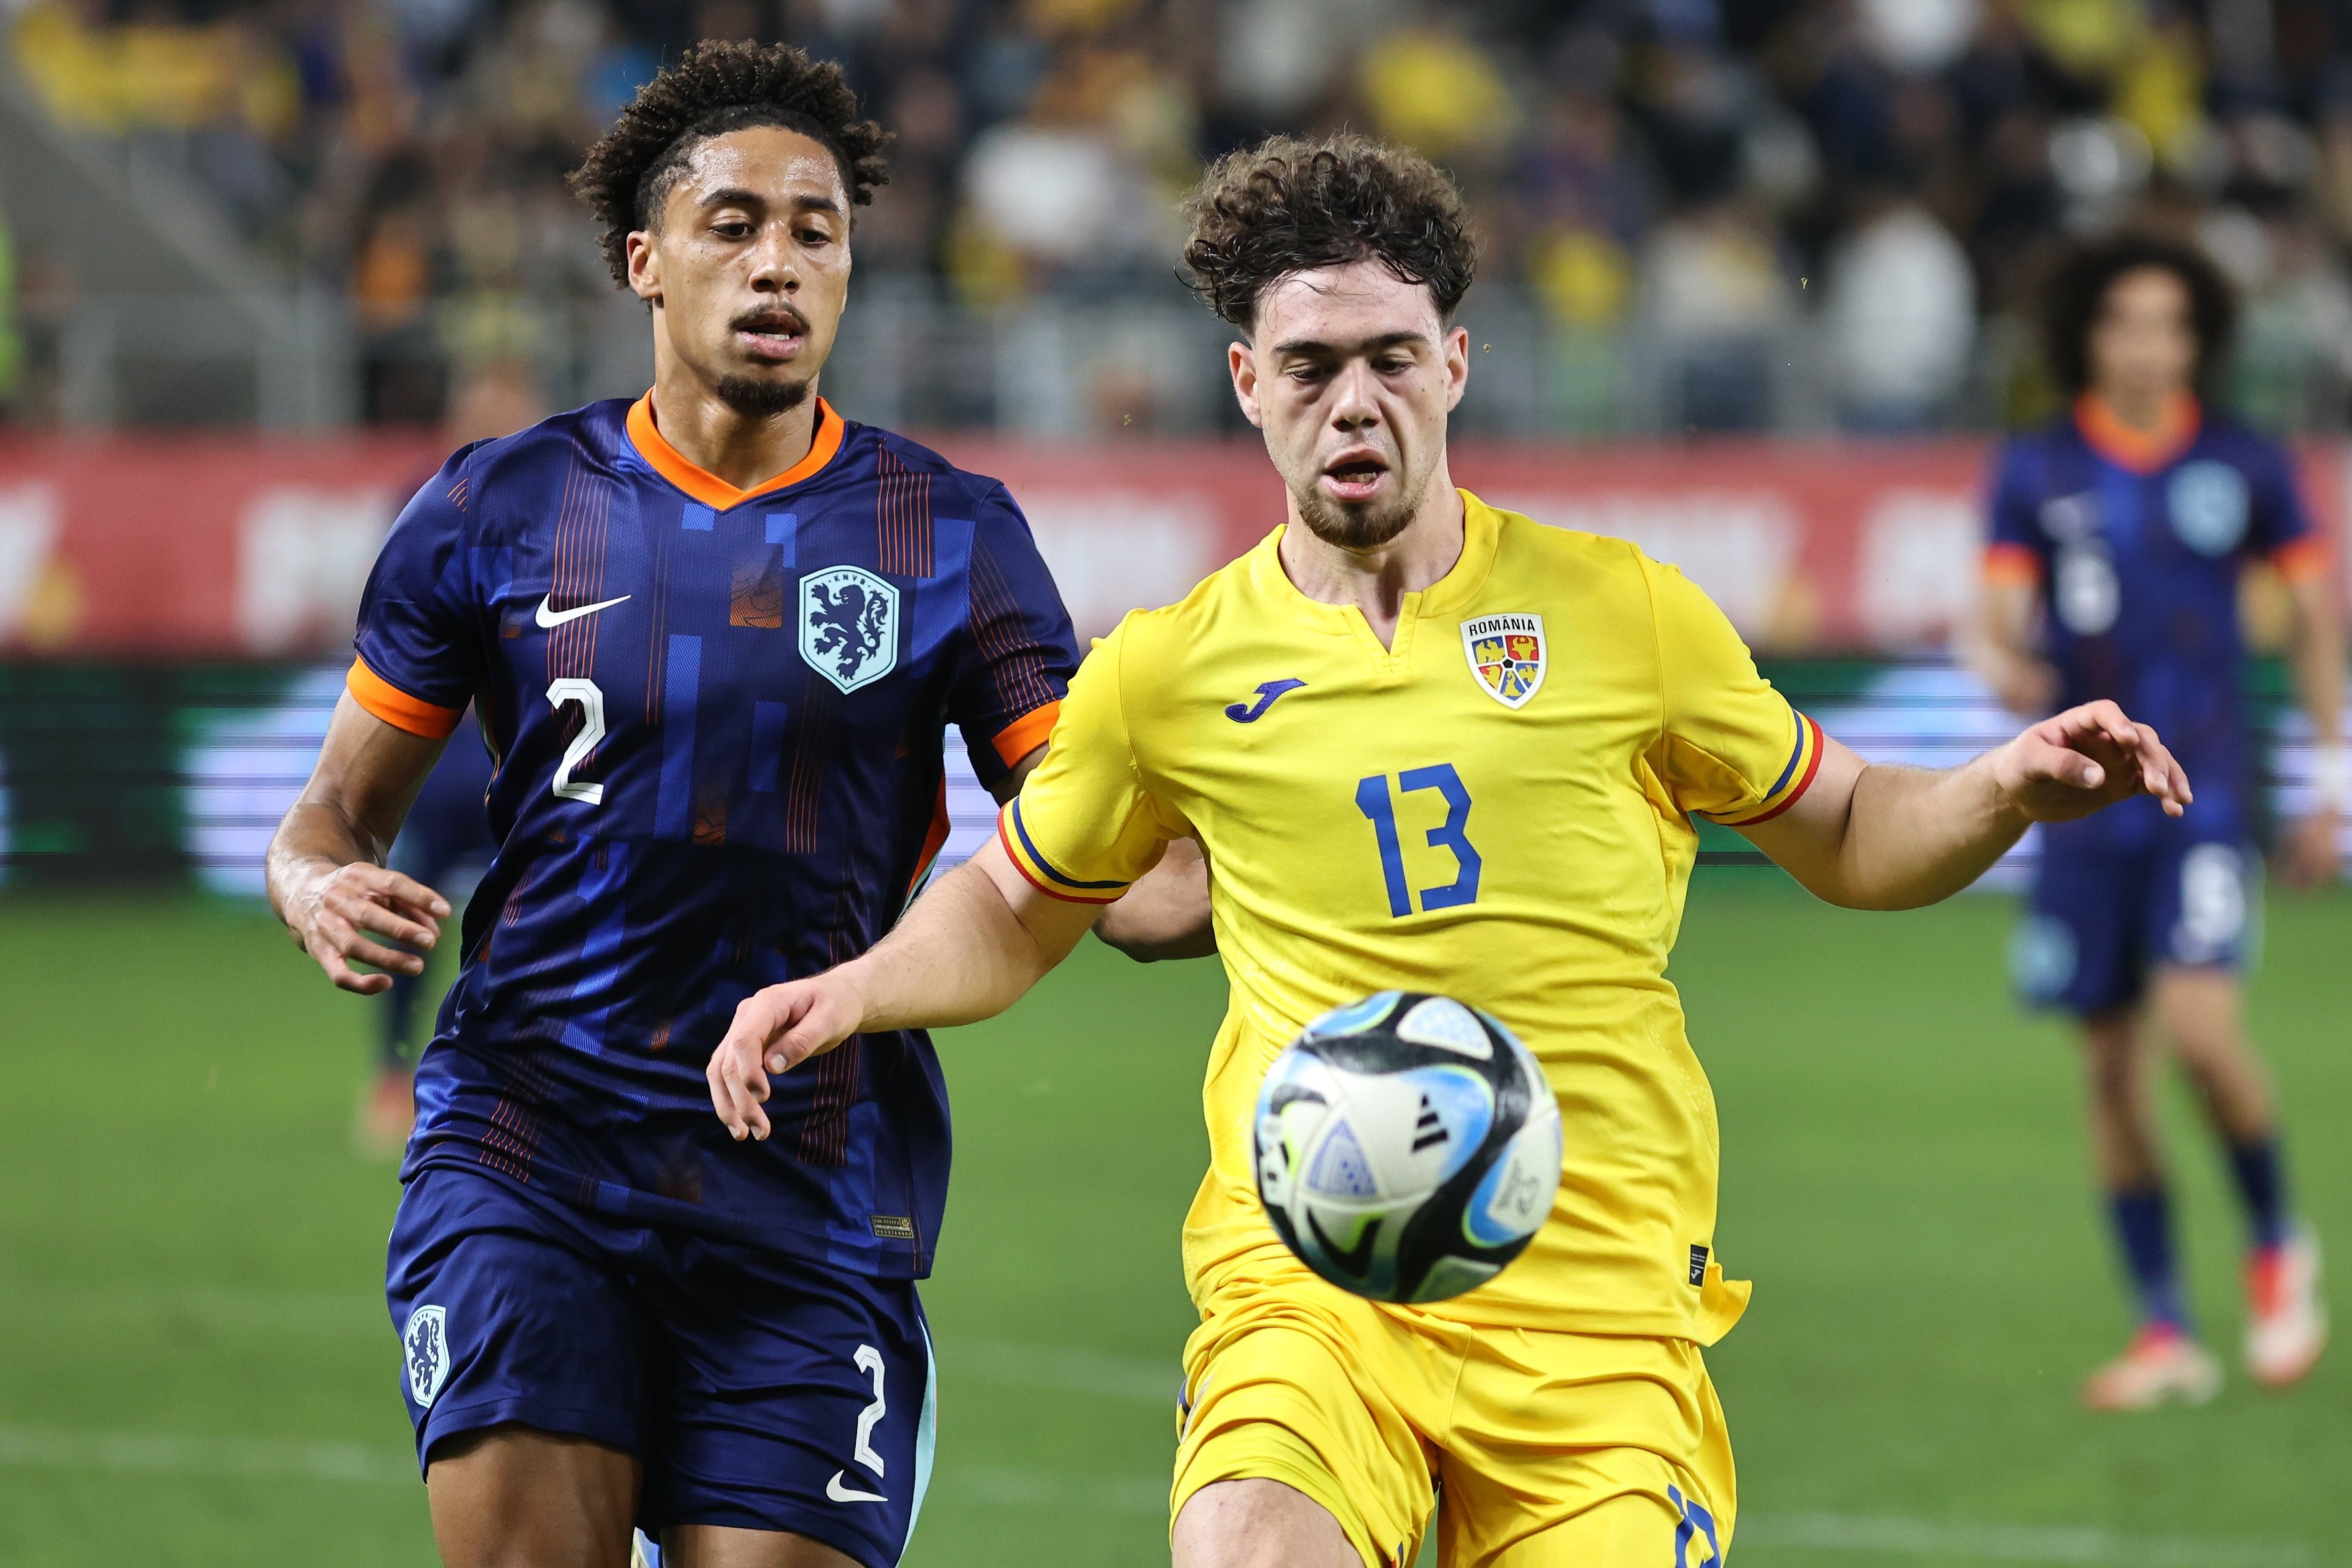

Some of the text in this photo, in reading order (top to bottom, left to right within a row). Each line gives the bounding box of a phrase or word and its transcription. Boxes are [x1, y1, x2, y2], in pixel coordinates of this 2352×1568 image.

[833, 574, 866, 585] KNVB
[1468, 616, 1535, 636] ROMÂNIA
[545, 678, 606, 805] 2
[1355, 763, 1482, 918] 13
[853, 1344, 886, 1479] 2
